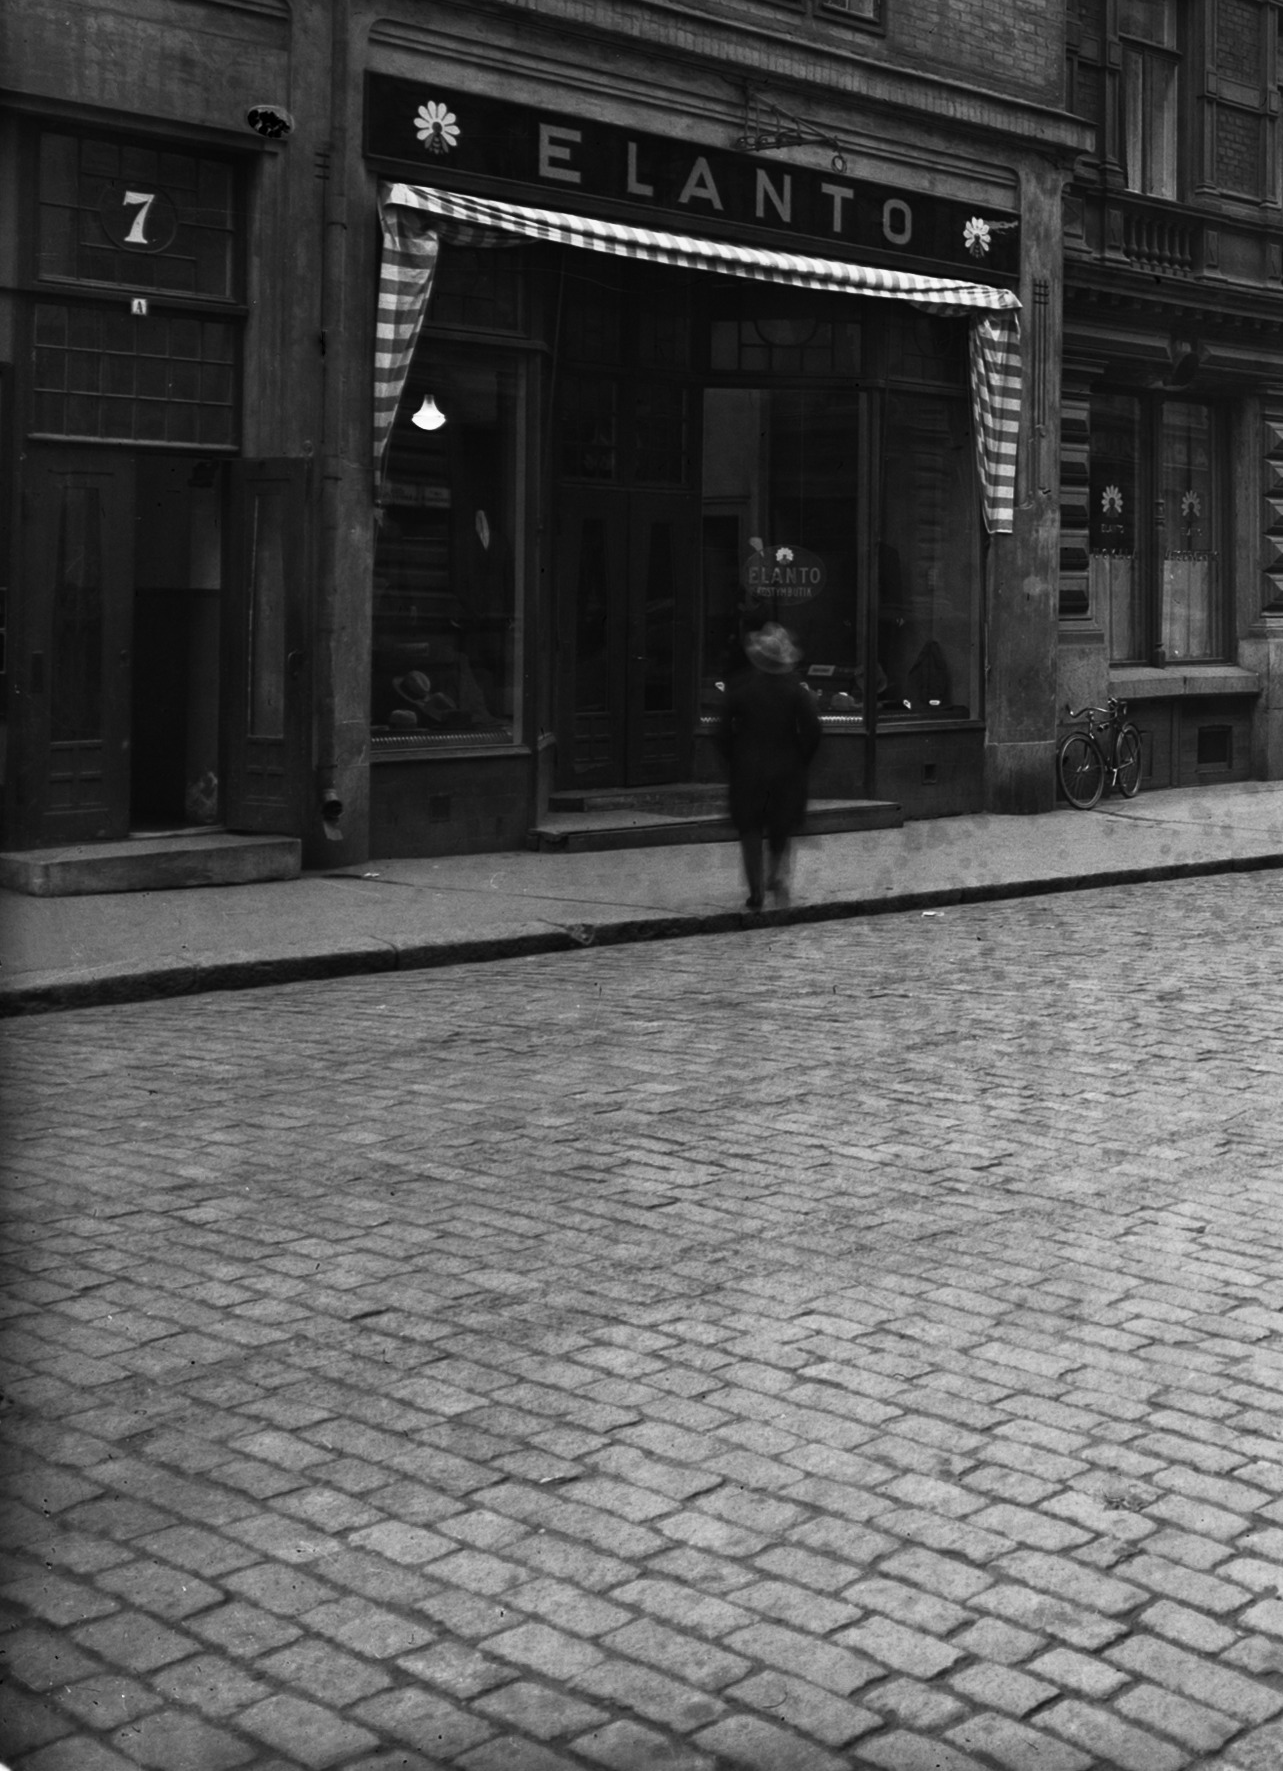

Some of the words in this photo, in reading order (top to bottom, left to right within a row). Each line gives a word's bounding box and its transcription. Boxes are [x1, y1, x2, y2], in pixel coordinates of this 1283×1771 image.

[538, 123, 913, 245] ELANTO
[122, 190, 156, 245] 7
[748, 566, 821, 584] ELANTO
[757, 586, 813, 597] KOSTYMBUTIK
